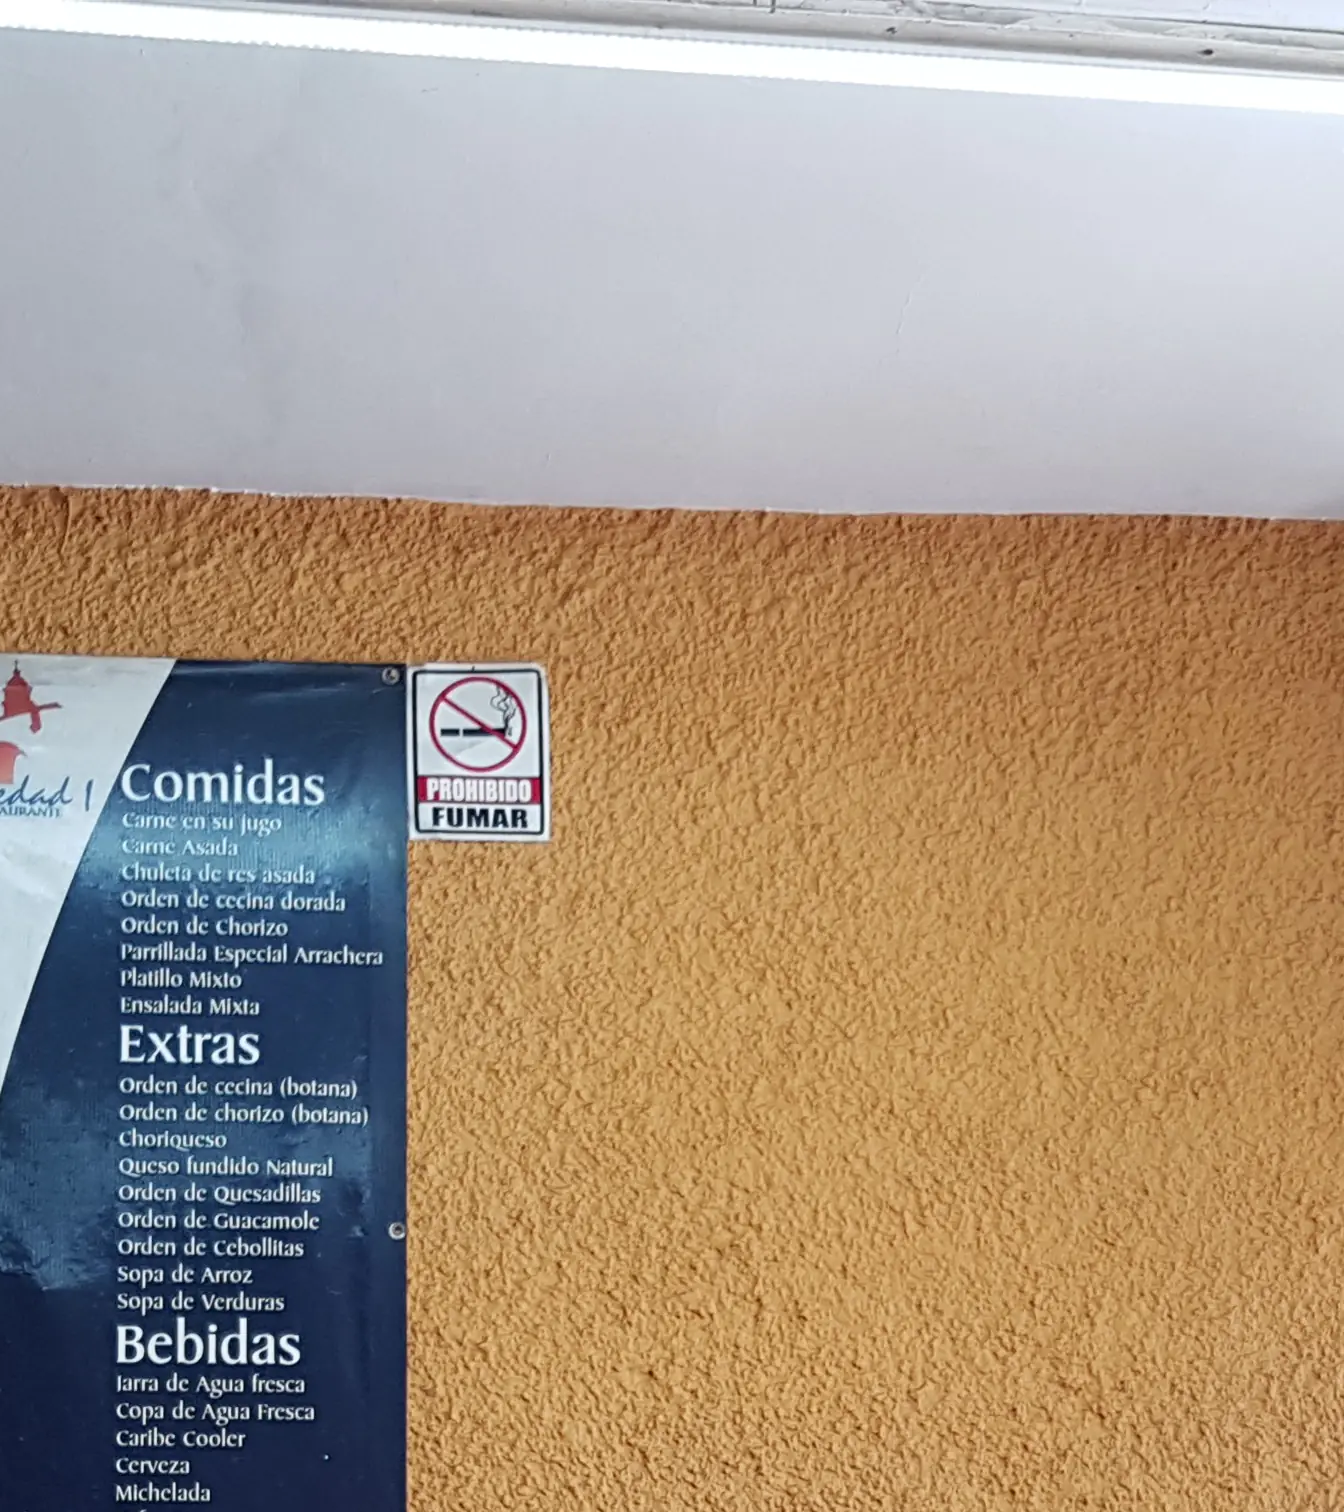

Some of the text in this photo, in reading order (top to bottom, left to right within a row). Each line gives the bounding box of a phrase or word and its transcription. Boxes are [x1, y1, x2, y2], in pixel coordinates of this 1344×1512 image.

[120, 758, 326, 806] Comidas
[426, 778, 531, 802] PROHIBIDO
[122, 812, 282, 837] Carne en su jugo
[432, 807, 528, 828] FUMAR
[122, 838, 238, 856] Carne Asada
[122, 864, 315, 884] Chuleta de res asada
[122, 889, 345, 912] Orden de cecina dorada
[121, 916, 288, 937] Orden de Chorizo
[120, 941, 383, 968] Parrillada Especial Arrachera
[120, 968, 242, 989] Platillo Mixto
[120, 994, 260, 1016] Ensalada Mixta
[119, 1024, 260, 1065] Extras
[119, 1075, 357, 1100] Orden de cecina (botana)
[119, 1101, 369, 1127] Orden de chorizo (botana)
[119, 1128, 227, 1152] Choriqueso
[119, 1155, 333, 1177] Queso fundido Natural
[118, 1182, 321, 1205] Orden de Quesadillas
[118, 1209, 320, 1230] Orden de Guacamole
[118, 1236, 304, 1257] Orden de Cebollitas
[118, 1263, 253, 1288] Sopa de Arroz
[117, 1291, 285, 1316] Sopa de Verduras
[116, 1316, 301, 1366] Bebidas
[116, 1373, 305, 1398] Jarra de Agua fresca
[116, 1401, 315, 1426] Copa de Agua Fresca
[116, 1427, 246, 1448] Caribe Cooler
[116, 1458, 190, 1474] Cerveza
[116, 1482, 211, 1502] Michelada
